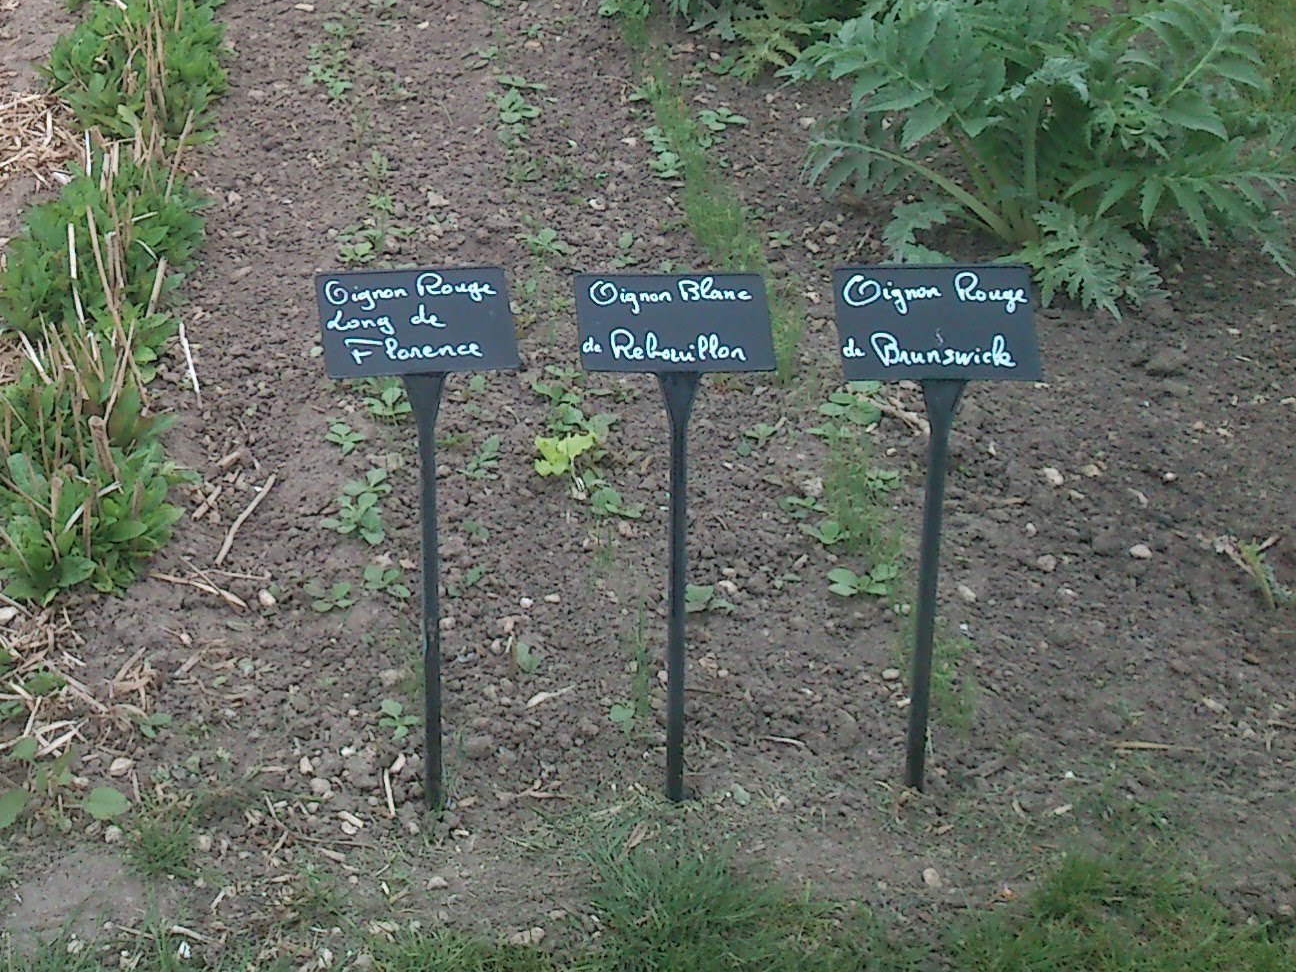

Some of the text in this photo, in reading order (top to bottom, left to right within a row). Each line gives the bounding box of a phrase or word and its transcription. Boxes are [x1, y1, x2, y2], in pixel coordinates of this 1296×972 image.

[325, 272, 498, 311] Oignon Rouge
[589, 276, 753, 316] Oignon Blanc
[842, 270, 1029, 315] Oignon Rouge
[326, 304, 448, 336] Long de
[343, 337, 484, 365] Florence
[581, 327, 748, 363] de Rebouillon
[842, 331, 1017, 368] de Brunswick
